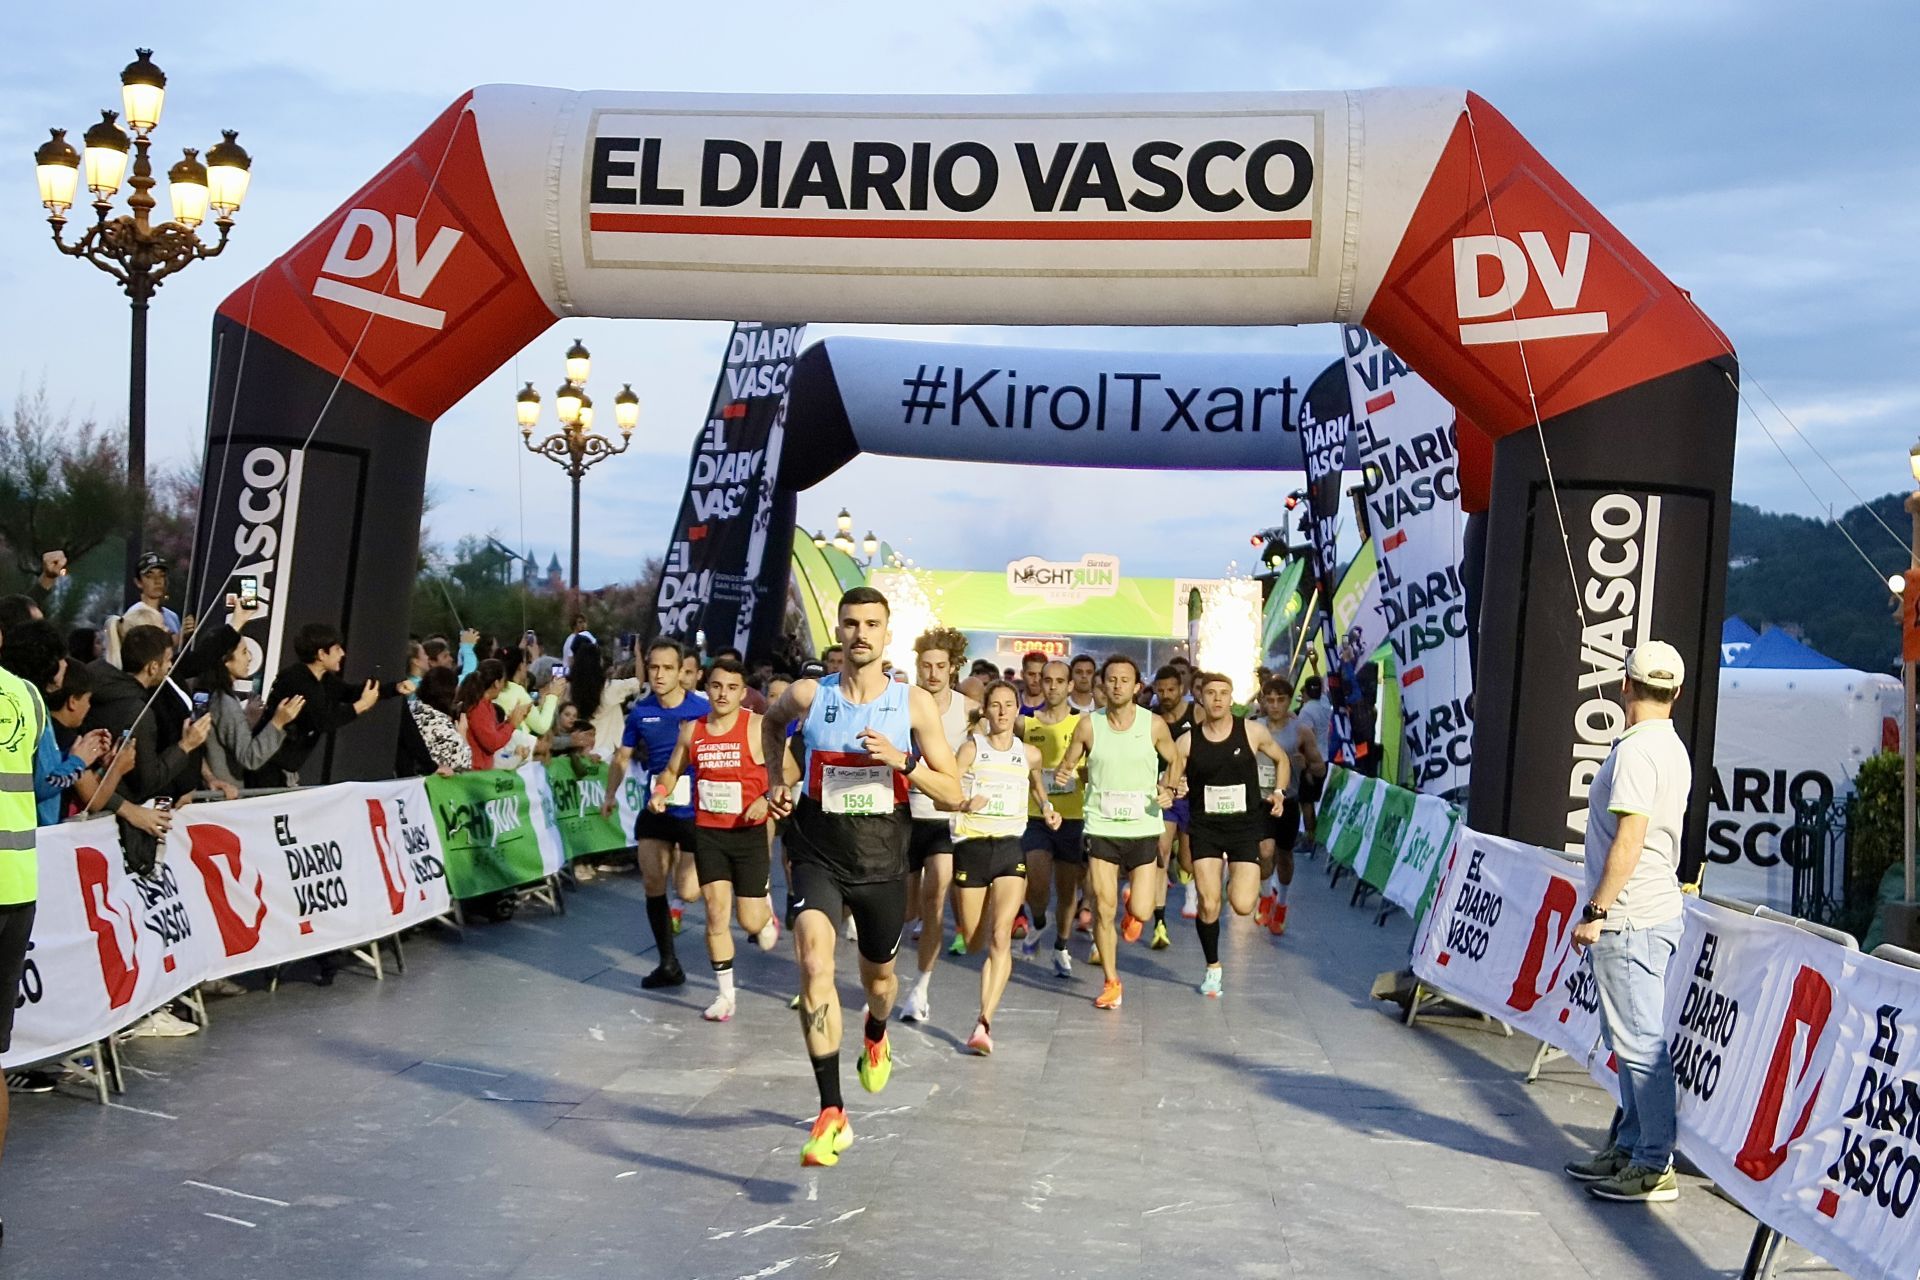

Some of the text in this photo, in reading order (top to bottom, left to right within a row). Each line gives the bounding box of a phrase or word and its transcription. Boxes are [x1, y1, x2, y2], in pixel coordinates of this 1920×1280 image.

[590, 137, 1314, 212] EL DIARIO VASCO
[321, 208, 464, 299] DV
[1453, 231, 1590, 318] DV
[902, 364, 1298, 432] #KirolTxart
[1356, 418, 1391, 457] EL
[1370, 466, 1461, 530] VASC
[1578, 493, 1642, 690] VASCO
[274, 814, 297, 846] EL
[843, 794, 873, 808] 1534
[284, 841, 342, 880] DIARIO
[1466, 850, 1485, 882] EL
[294, 876, 347, 916] VASCO
[1455, 883, 1503, 927] DIARIO
[1446, 917, 1490, 962] VASCO
[1694, 932, 1718, 982] EL
[1679, 981, 1739, 1048] DIARIO
[1869, 1004, 1903, 1066] EL
[1669, 1032, 1722, 1102] VASCO
[1827, 1126, 1920, 1219] VASCO
